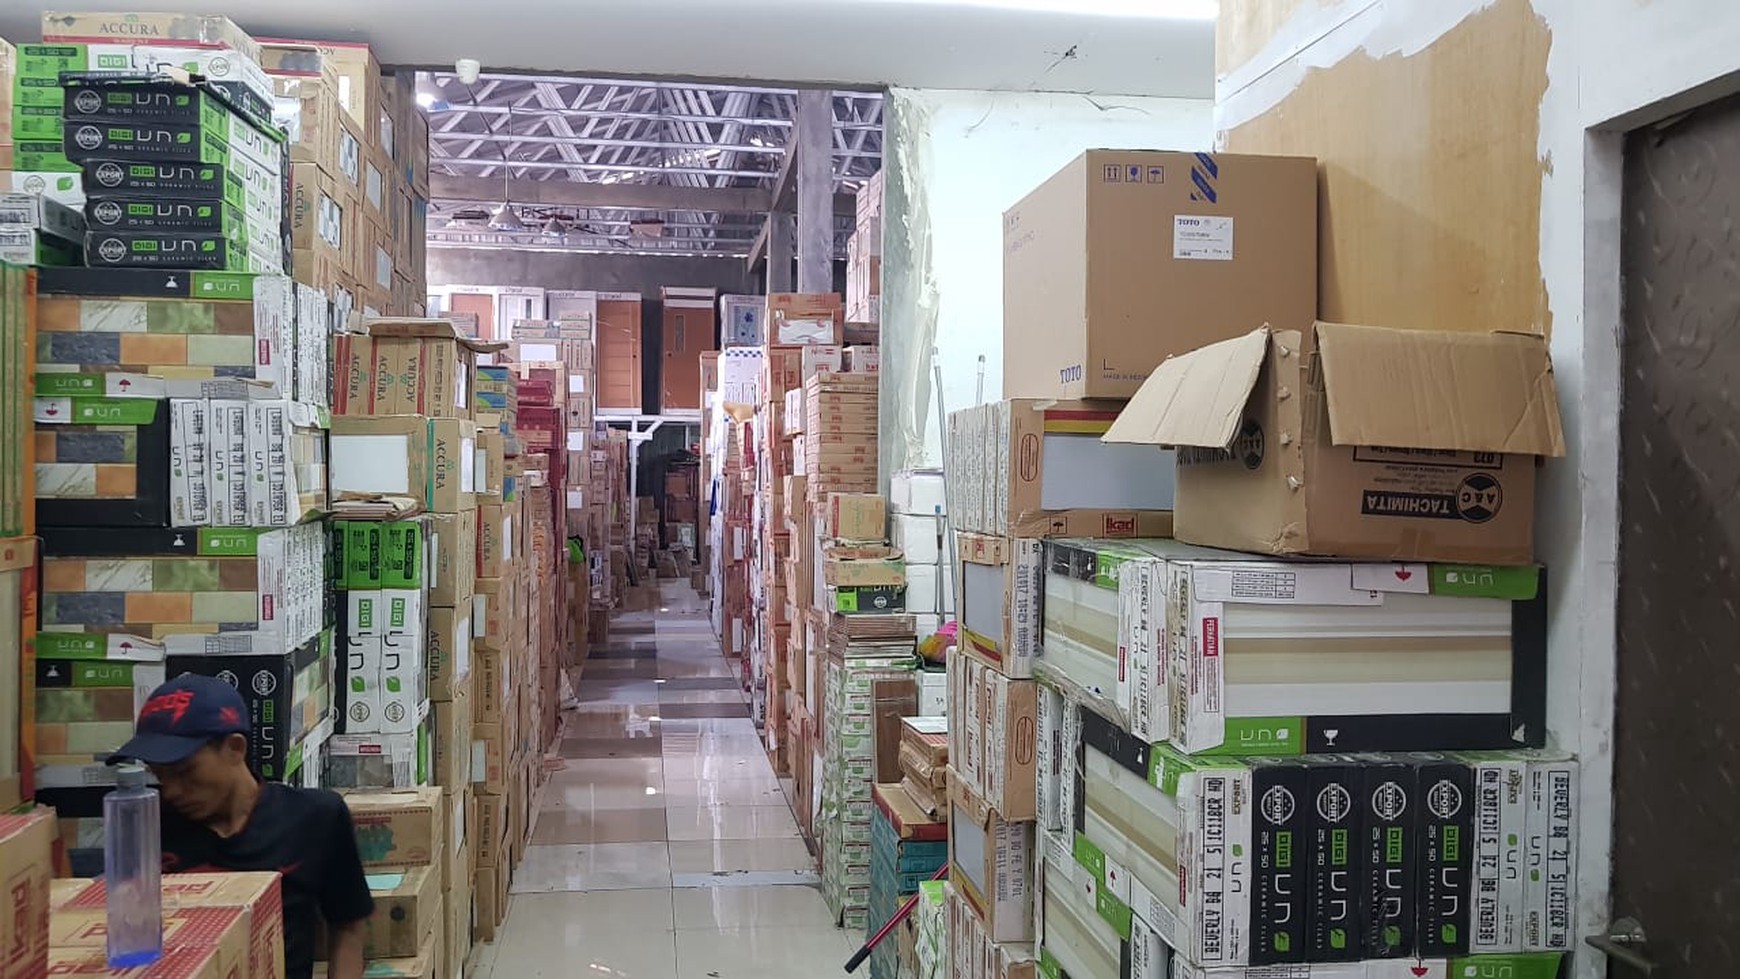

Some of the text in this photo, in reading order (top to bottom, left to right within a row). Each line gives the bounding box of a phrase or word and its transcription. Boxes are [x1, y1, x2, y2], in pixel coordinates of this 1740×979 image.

[100, 22, 159, 35] ACCURA
[294, 182, 305, 229] ACCURA
[349, 353, 360, 399] ACCURA
[377, 355, 388, 401] ACCURA
[407, 356, 417, 403] ACCURA
[1060, 364, 1081, 384] TOTO
[436, 439, 446, 489] ACCURA
[1367, 496, 1449, 513] TACHIMITA
[359, 599, 372, 627] DIGI
[392, 599, 405, 627] DIGI
[429, 630, 440, 682] ACCURA
[1208, 779, 1222, 792] HD
[1484, 770, 1498, 783] HD
[1233, 779, 1241, 815] EXPORT
[1273, 785, 1281, 826] EXPORT
[1329, 783, 1338, 823] EXPORT
[1385, 782, 1393, 821] EXPORT
[1553, 777, 1567, 819] BEVERLY
[1262, 832, 1268, 845] 25
[1318, 829, 1324, 842] 25
[1373, 827, 1379, 840] 25
[1386, 828, 1402, 863] DIGI
[1429, 825, 1436, 838] 25
[1443, 826, 1458, 861] DIGI
[1261, 855, 1269, 868] 50
[1276, 832, 1291, 867] DIGI
[1318, 852, 1324, 865] 50
[1332, 830, 1347, 865] DIGI
[1372, 850, 1379, 863] 50
[1429, 848, 1435, 861] 50
[1483, 856, 1496, 868] 21
[1552, 850, 1566, 860] 21
[1207, 869, 1221, 879] 21
[1205, 911, 1220, 953] BEVERLY
[1479, 897, 1495, 940] BEVERLY
[1530, 911, 1538, 947] EXPORT
